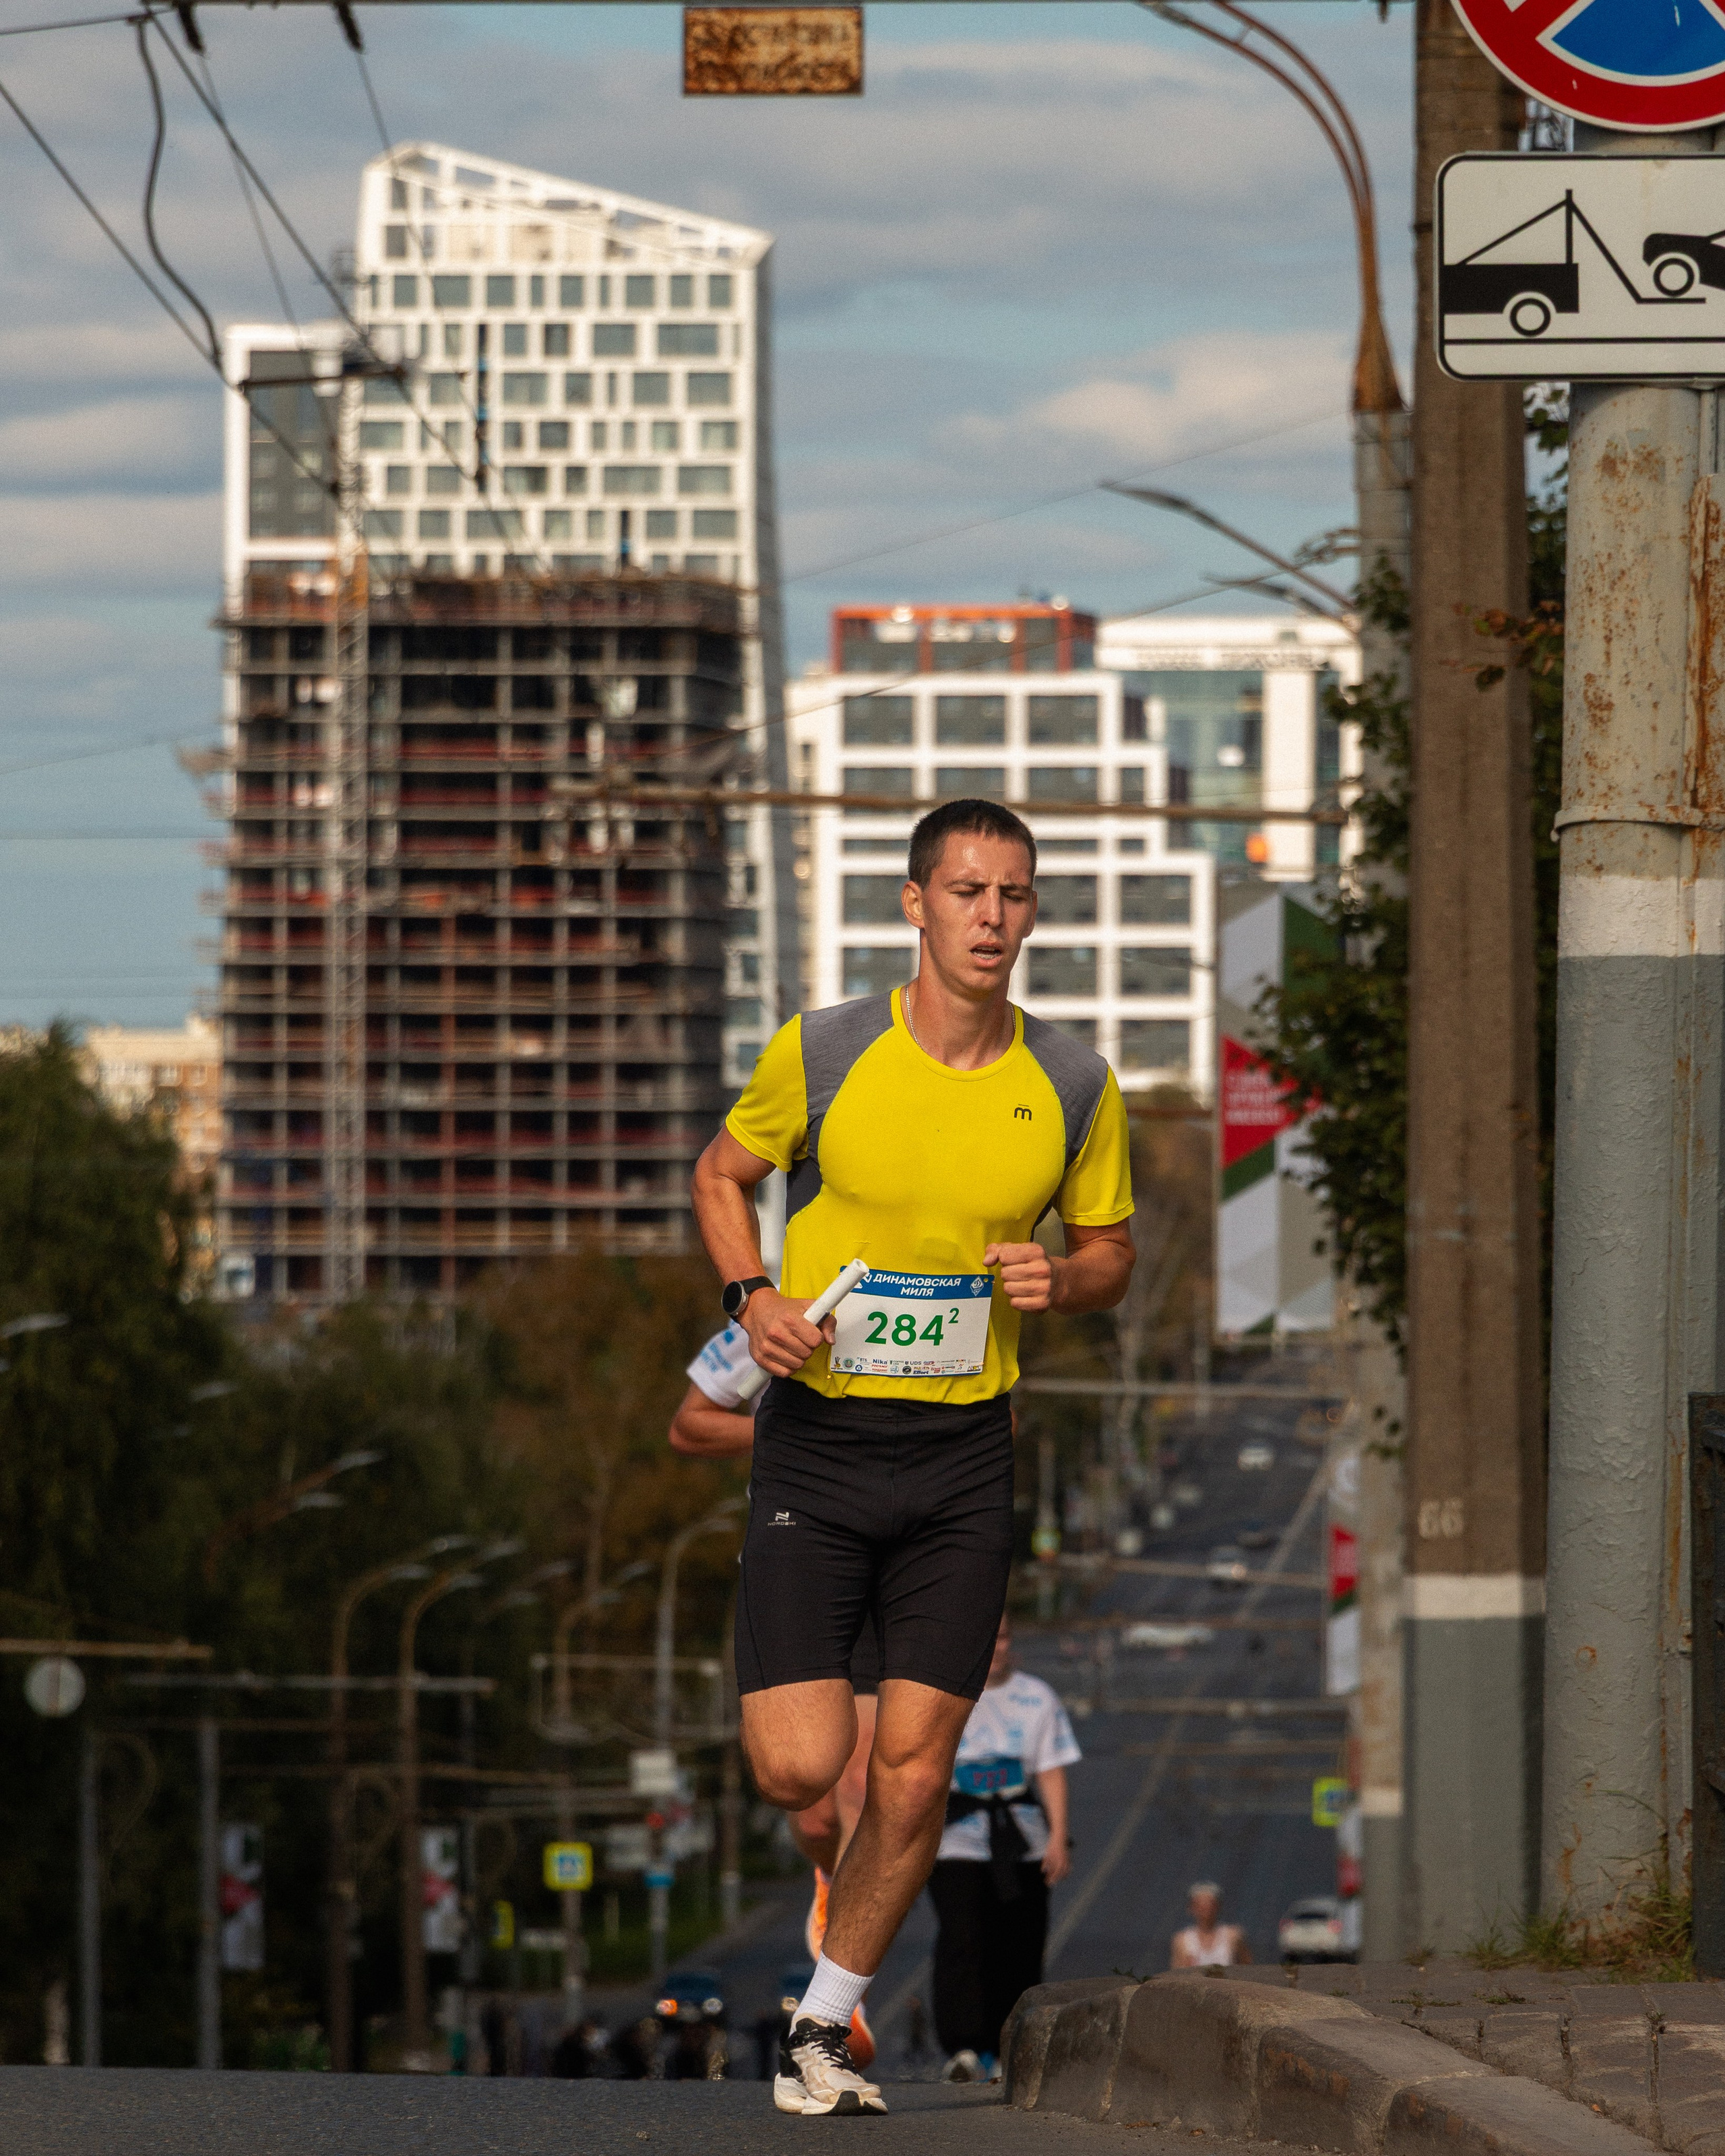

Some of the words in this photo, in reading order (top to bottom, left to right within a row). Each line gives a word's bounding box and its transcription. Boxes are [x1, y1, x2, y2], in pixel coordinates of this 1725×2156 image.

[873, 1273, 962, 1287] ДИНАМОВСКАЯ
[900, 1287, 934, 1297] МИЛЯ
[865, 1311, 944, 1346] 284
